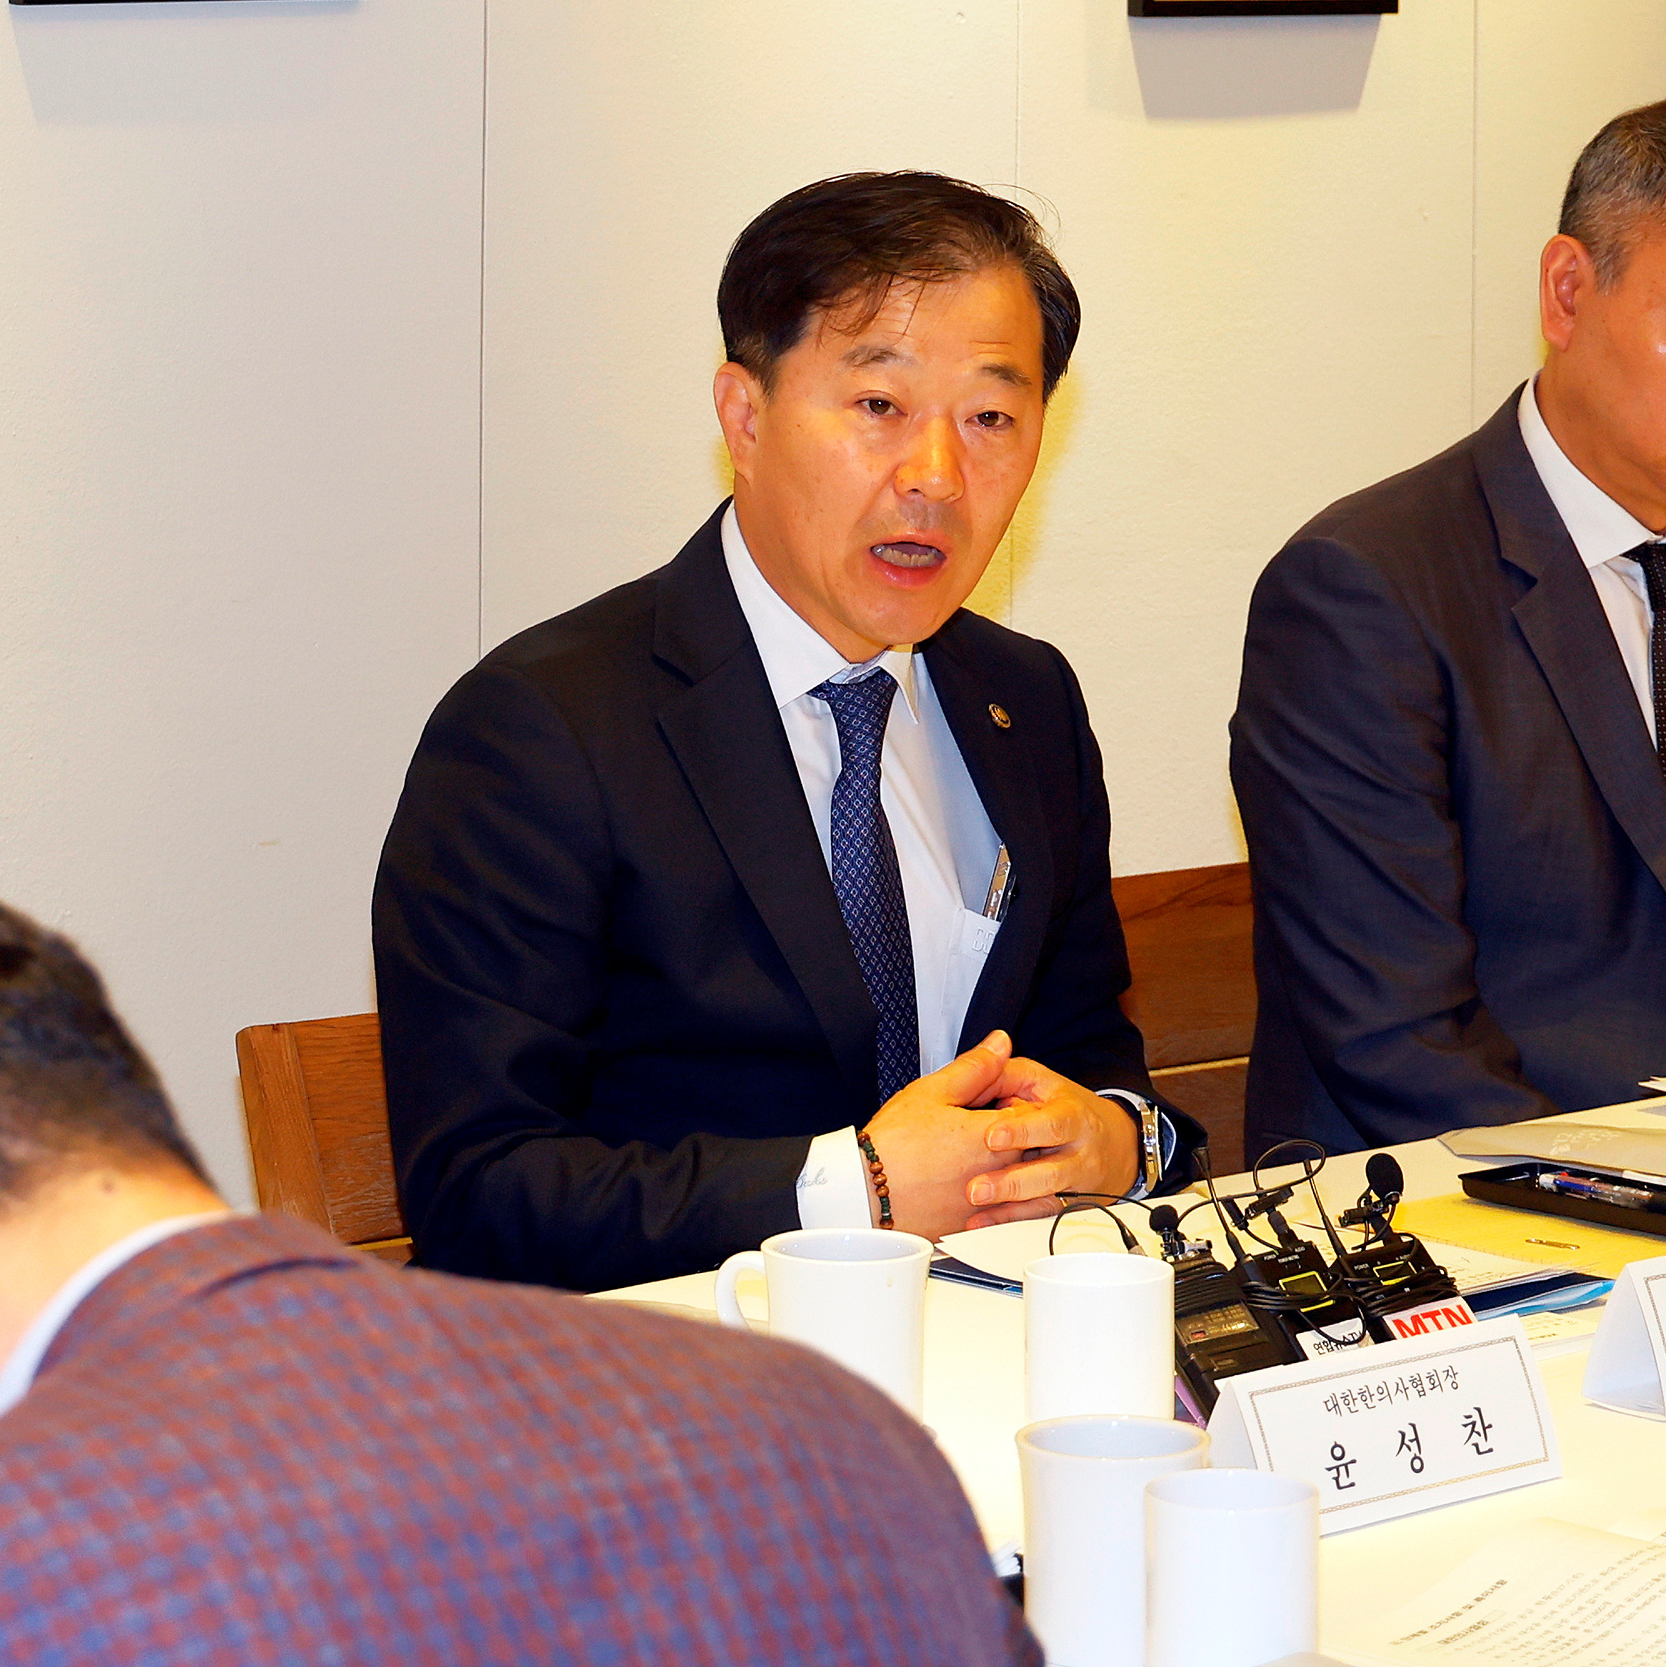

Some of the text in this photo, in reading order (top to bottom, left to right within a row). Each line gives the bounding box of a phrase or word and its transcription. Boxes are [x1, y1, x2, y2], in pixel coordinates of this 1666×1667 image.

[1393, 1304, 1473, 1339] MTN
[1323, 1364, 1460, 1417] 대한한의사협회장
[1324, 1406, 1494, 1491] 윤 성 찬
